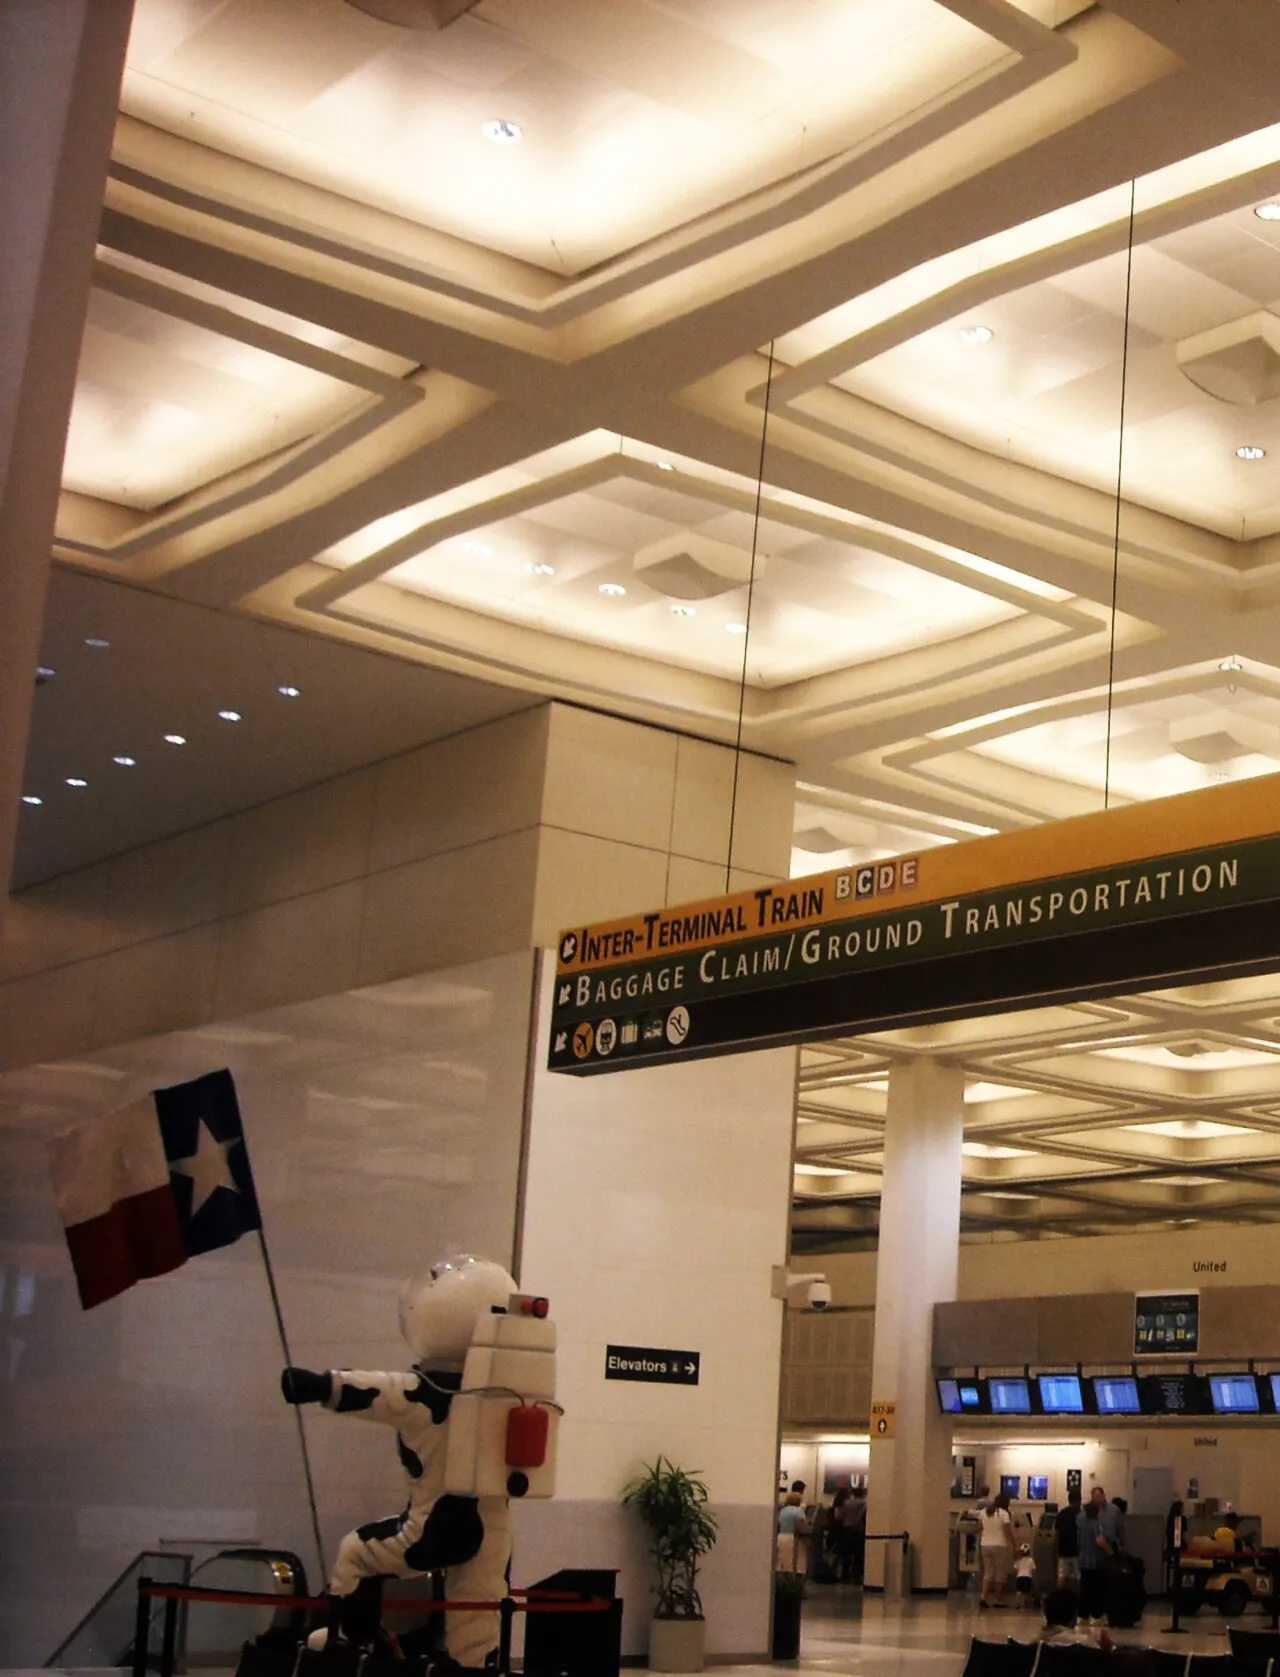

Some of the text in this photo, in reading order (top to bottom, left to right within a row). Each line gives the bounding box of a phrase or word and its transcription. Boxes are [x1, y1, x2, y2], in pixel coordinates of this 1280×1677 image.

[575, 965, 685, 1006] BAGGAGE
[940, 858, 1239, 939] TRANSPORTATION
[580, 906, 747, 963] INTER-TERMINAL
[755, 887, 824, 927] TRAIN
[1193, 1260, 1227, 1273] United
[608, 1356, 667, 1373] Elevators
